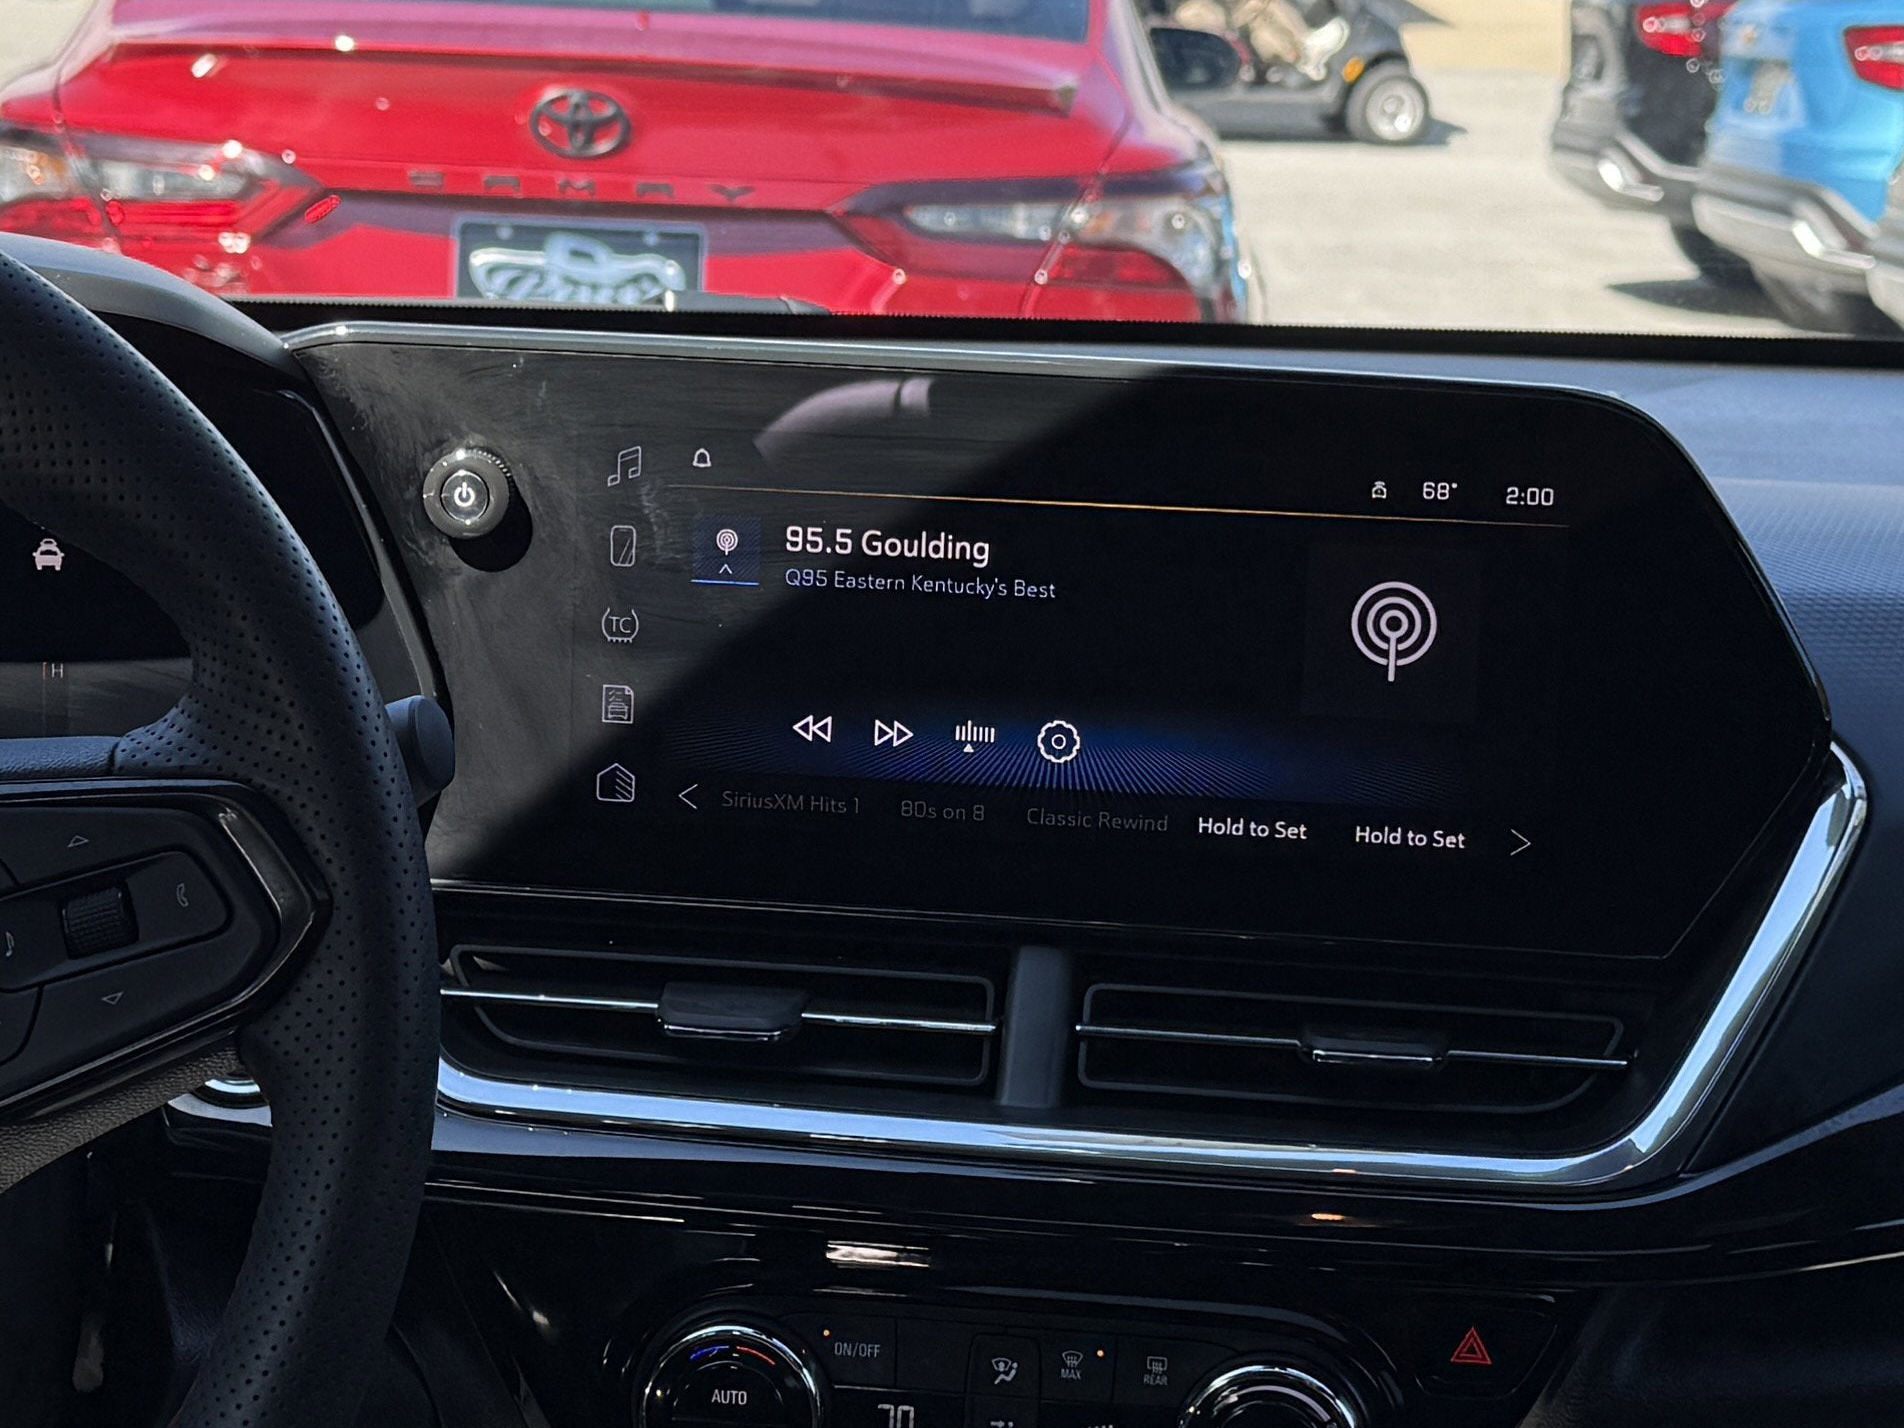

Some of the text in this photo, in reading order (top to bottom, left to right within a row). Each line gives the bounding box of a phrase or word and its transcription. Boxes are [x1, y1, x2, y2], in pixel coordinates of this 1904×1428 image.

[1506, 486, 1554, 506] 2:00
[785, 525, 990, 568] 95.5 Goulding
[785, 568, 1056, 599] Q95 Eastern Kentucky's Best
[51, 663, 63, 678] H
[721, 790, 860, 814] SiriusXM Hits 1
[901, 800, 985, 822] 80s on 8
[1027, 808, 1168, 833] Classic Rewind
[1198, 817, 1307, 840] Hold to Set
[1355, 826, 1466, 849] Hold to Set
[834, 1341, 881, 1359] ON/OFF
[1060, 1367, 1082, 1380] MAX
[1143, 1373, 1168, 1386] REAR
[711, 1388, 747, 1406] AUTO
